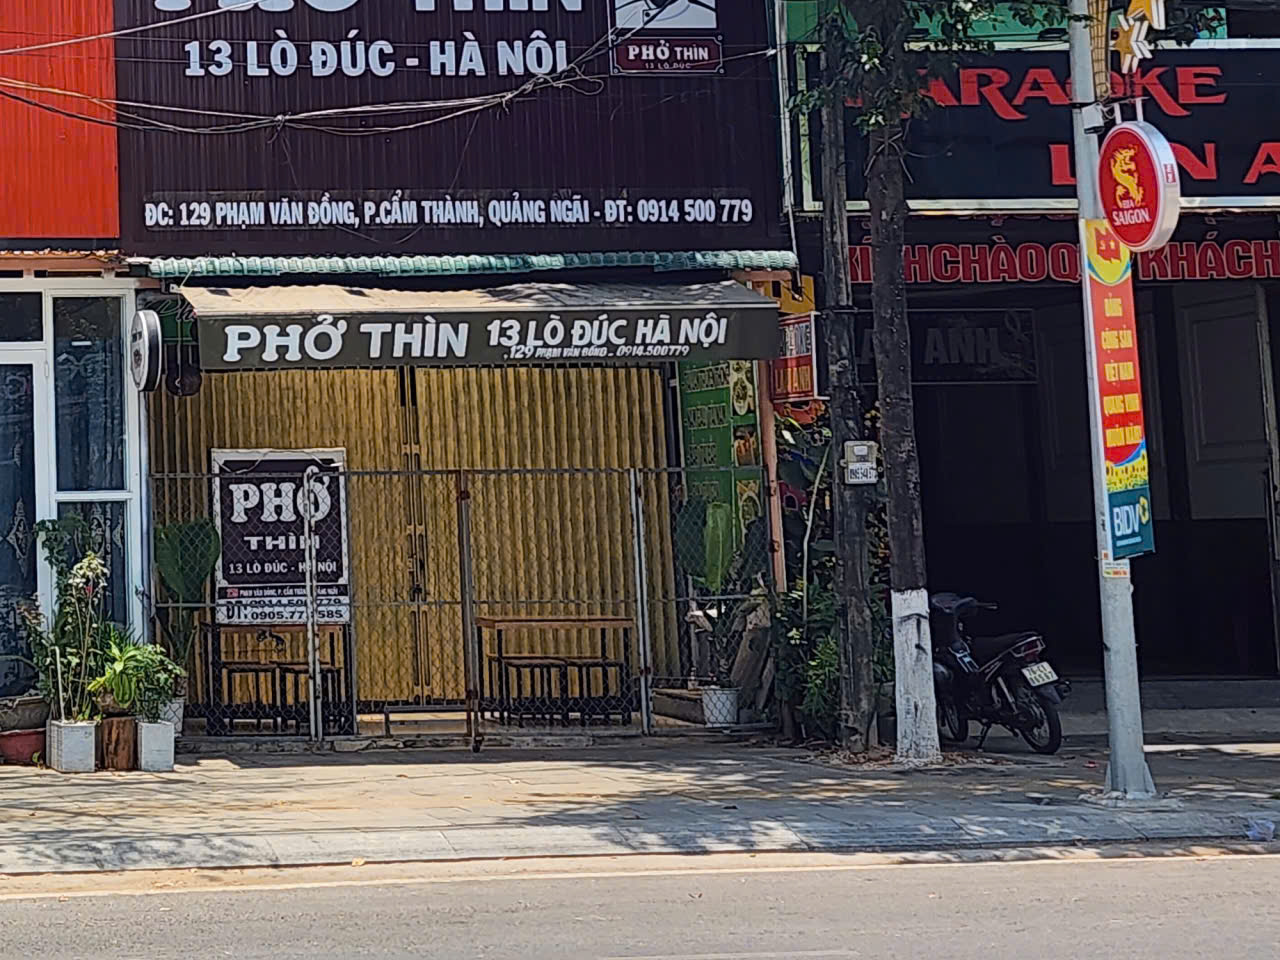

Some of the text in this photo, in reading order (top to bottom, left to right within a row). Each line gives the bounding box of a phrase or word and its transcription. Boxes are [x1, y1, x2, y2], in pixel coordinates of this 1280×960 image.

[184, 39, 233, 76] 13
[246, 29, 298, 76] LÒ
[309, 29, 396, 77] ĐÚC
[429, 31, 487, 76] HÀ
[627, 40, 670, 60] PHỞ
[845, 67, 1227, 120] ARAKE
[144, 201, 174, 226] ĐC:
[179, 201, 211, 226] 129
[216, 201, 265, 229] PHẠM
[269, 197, 303, 225] VĂN
[307, 191, 360, 229] ĐỒNG,
[488, 191, 546, 226] QUẢNG
[549, 194, 590, 223] NGÃI
[604, 199, 633, 223] ĐT:
[637, 199, 679, 222] 0914
[684, 199, 716, 222] 500
[720, 199, 753, 222] 779
[222, 314, 348, 362] PHỞ
[359, 315, 468, 358] THÌN
[486, 319, 520, 346] 13
[526, 314, 565, 346] LÒ
[570, 313, 628, 345] ĐÚC
[678, 312, 728, 348] NỘI
[229, 465, 332, 523] PHỞ
[1113, 503, 1139, 537] BIDV
[229, 563, 243, 574] 13
[246, 561, 261, 574] LÒ
[264, 560, 288, 574] ĐÚC
[298, 561, 312, 573] H
